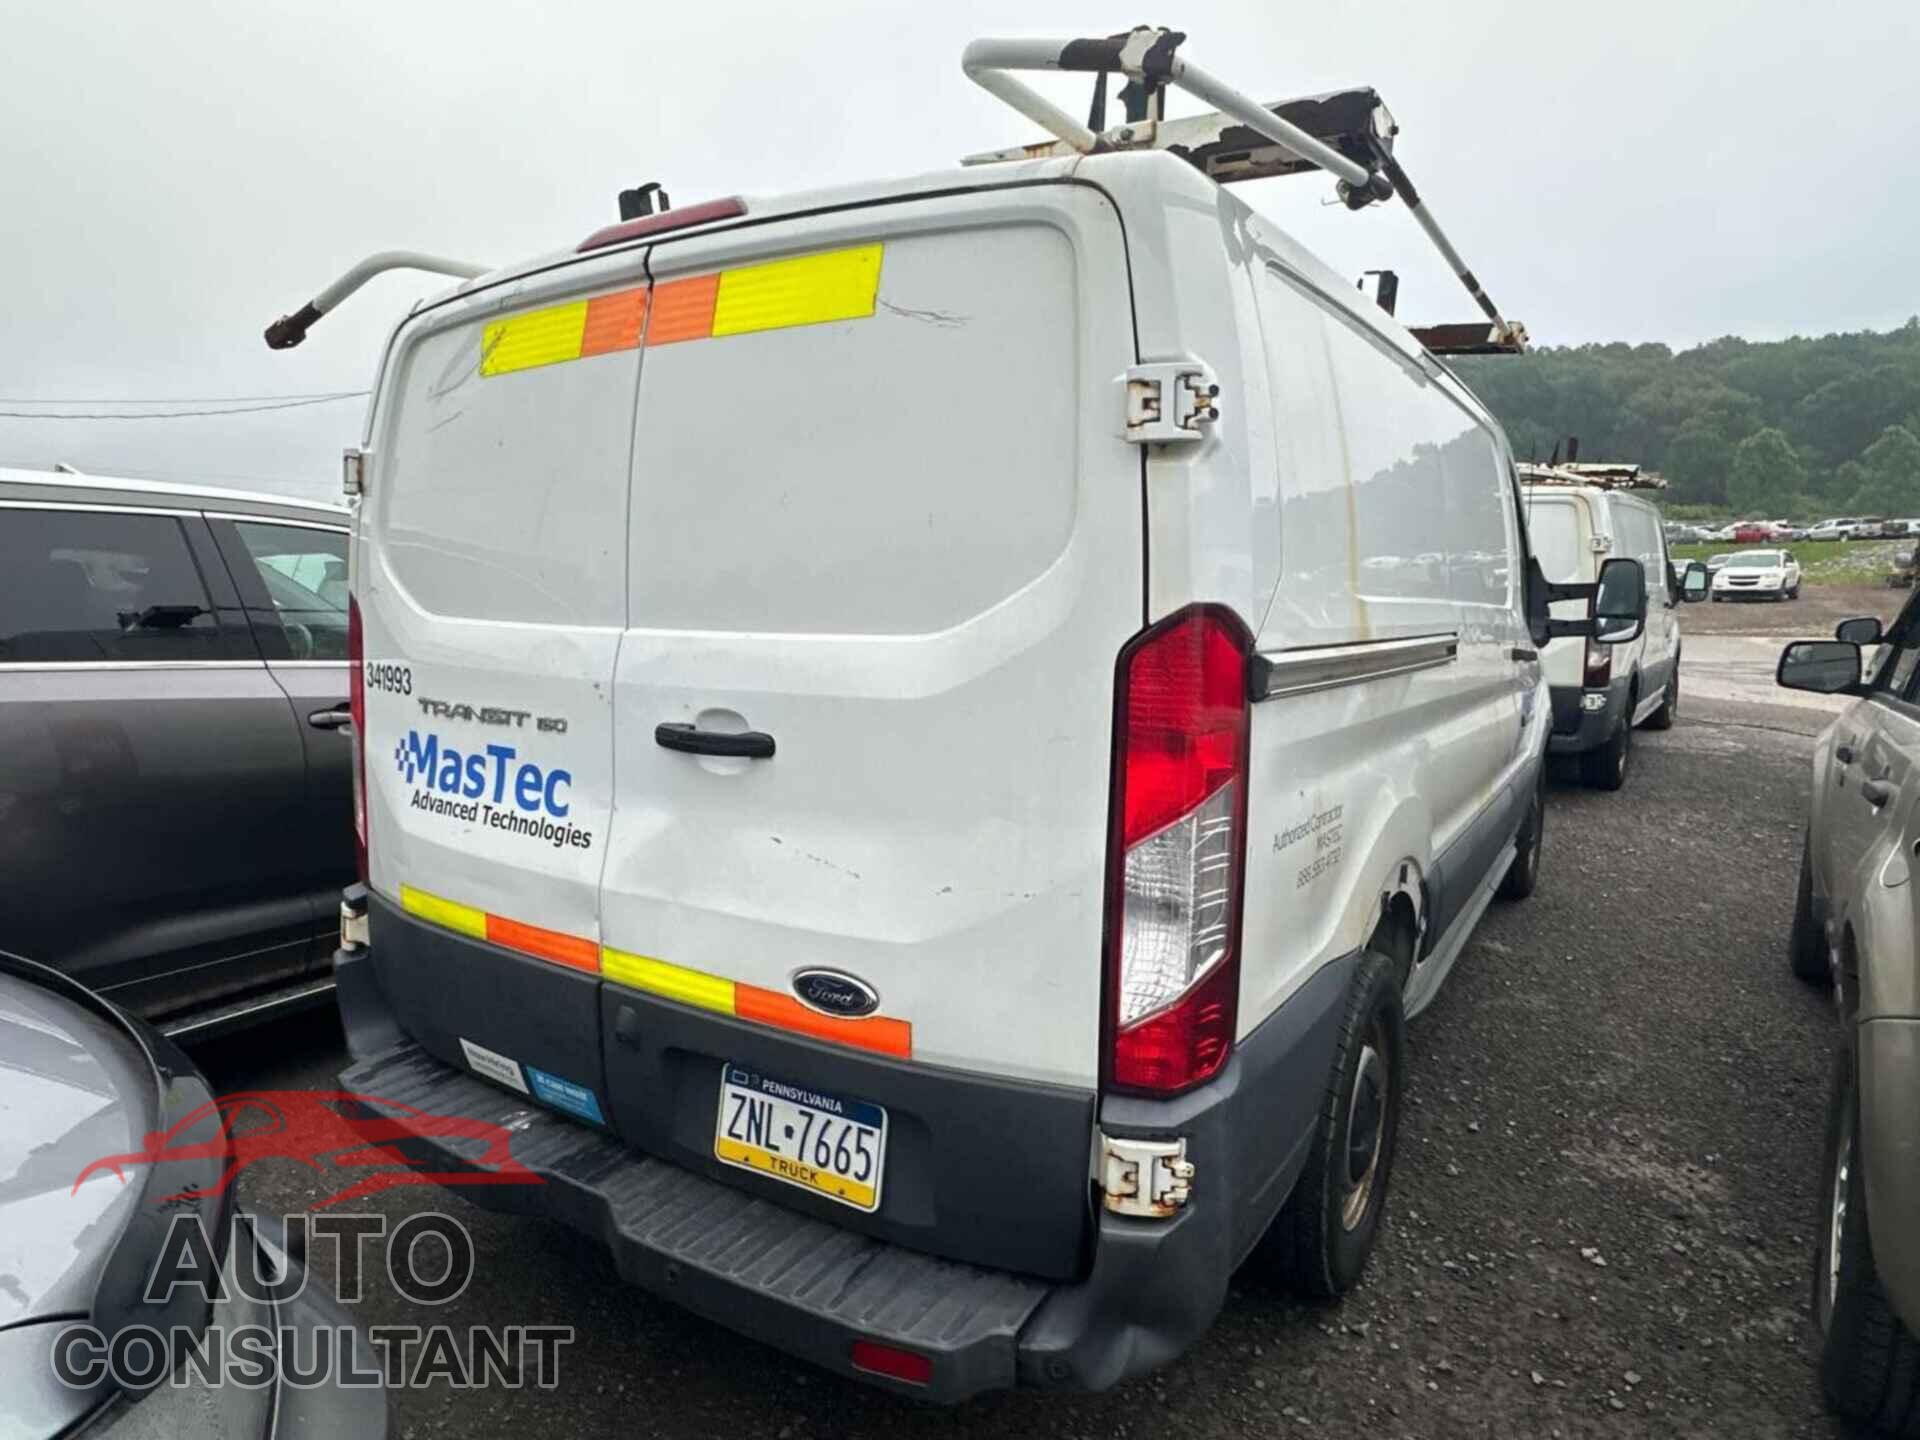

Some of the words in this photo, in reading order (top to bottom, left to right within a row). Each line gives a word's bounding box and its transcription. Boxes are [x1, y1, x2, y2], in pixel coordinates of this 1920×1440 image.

[366, 662, 412, 695] 341993
[417, 697, 531, 728] TRANSIT
[408, 730, 572, 818] MasTec
[411, 789, 479, 822] Advanced
[483, 804, 592, 849] Technologies
[808, 979, 854, 1007] Ford
[762, 1079, 843, 1114] PENNSYLVANIA
[769, 1157, 819, 1183] TRUCK
